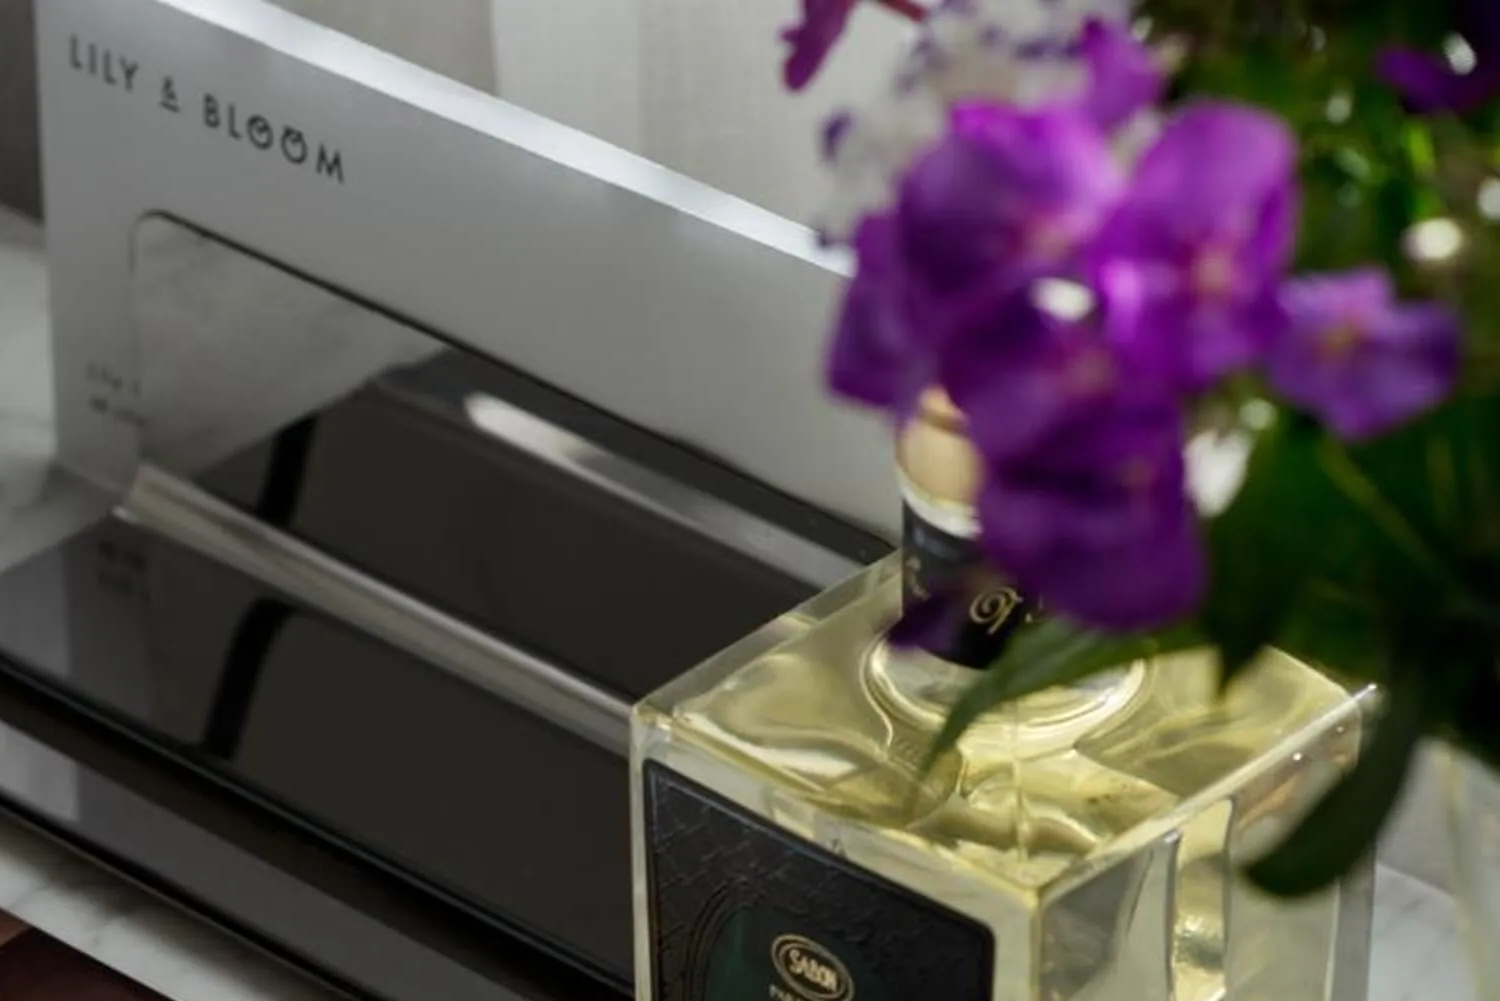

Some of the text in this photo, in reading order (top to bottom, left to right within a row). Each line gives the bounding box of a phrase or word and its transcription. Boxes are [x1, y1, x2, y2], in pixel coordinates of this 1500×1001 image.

[69, 34, 344, 184] LILY & BLOOM
[787, 949, 838, 991] SABON
